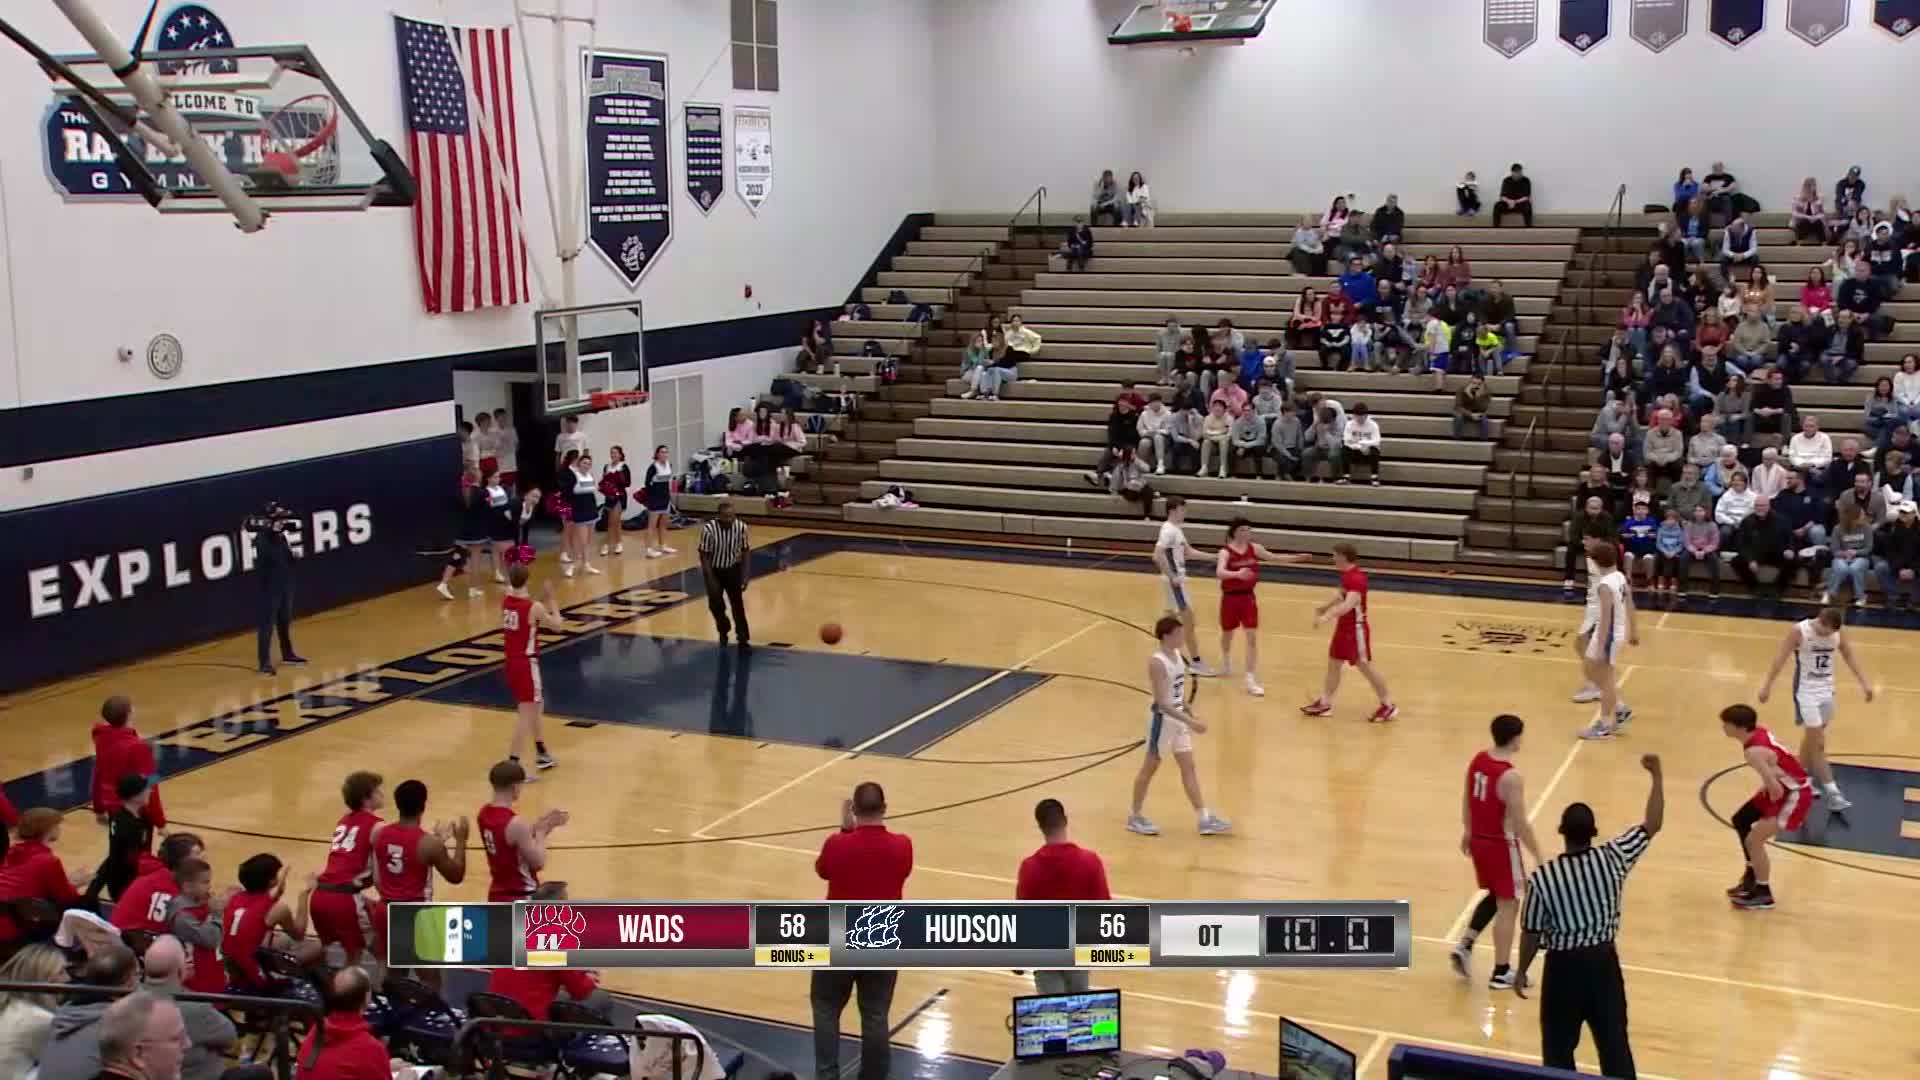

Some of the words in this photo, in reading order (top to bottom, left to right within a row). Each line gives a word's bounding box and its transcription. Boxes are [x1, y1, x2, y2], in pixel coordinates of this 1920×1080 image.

[174, 94, 226, 110] LCOME
[234, 99, 254, 115] TO
[1473, 771, 1488, 801] 11
[332, 825, 360, 852] 24
[386, 843, 404, 874] 3
[147, 891, 172, 922] 15
[230, 907, 246, 936] 1
